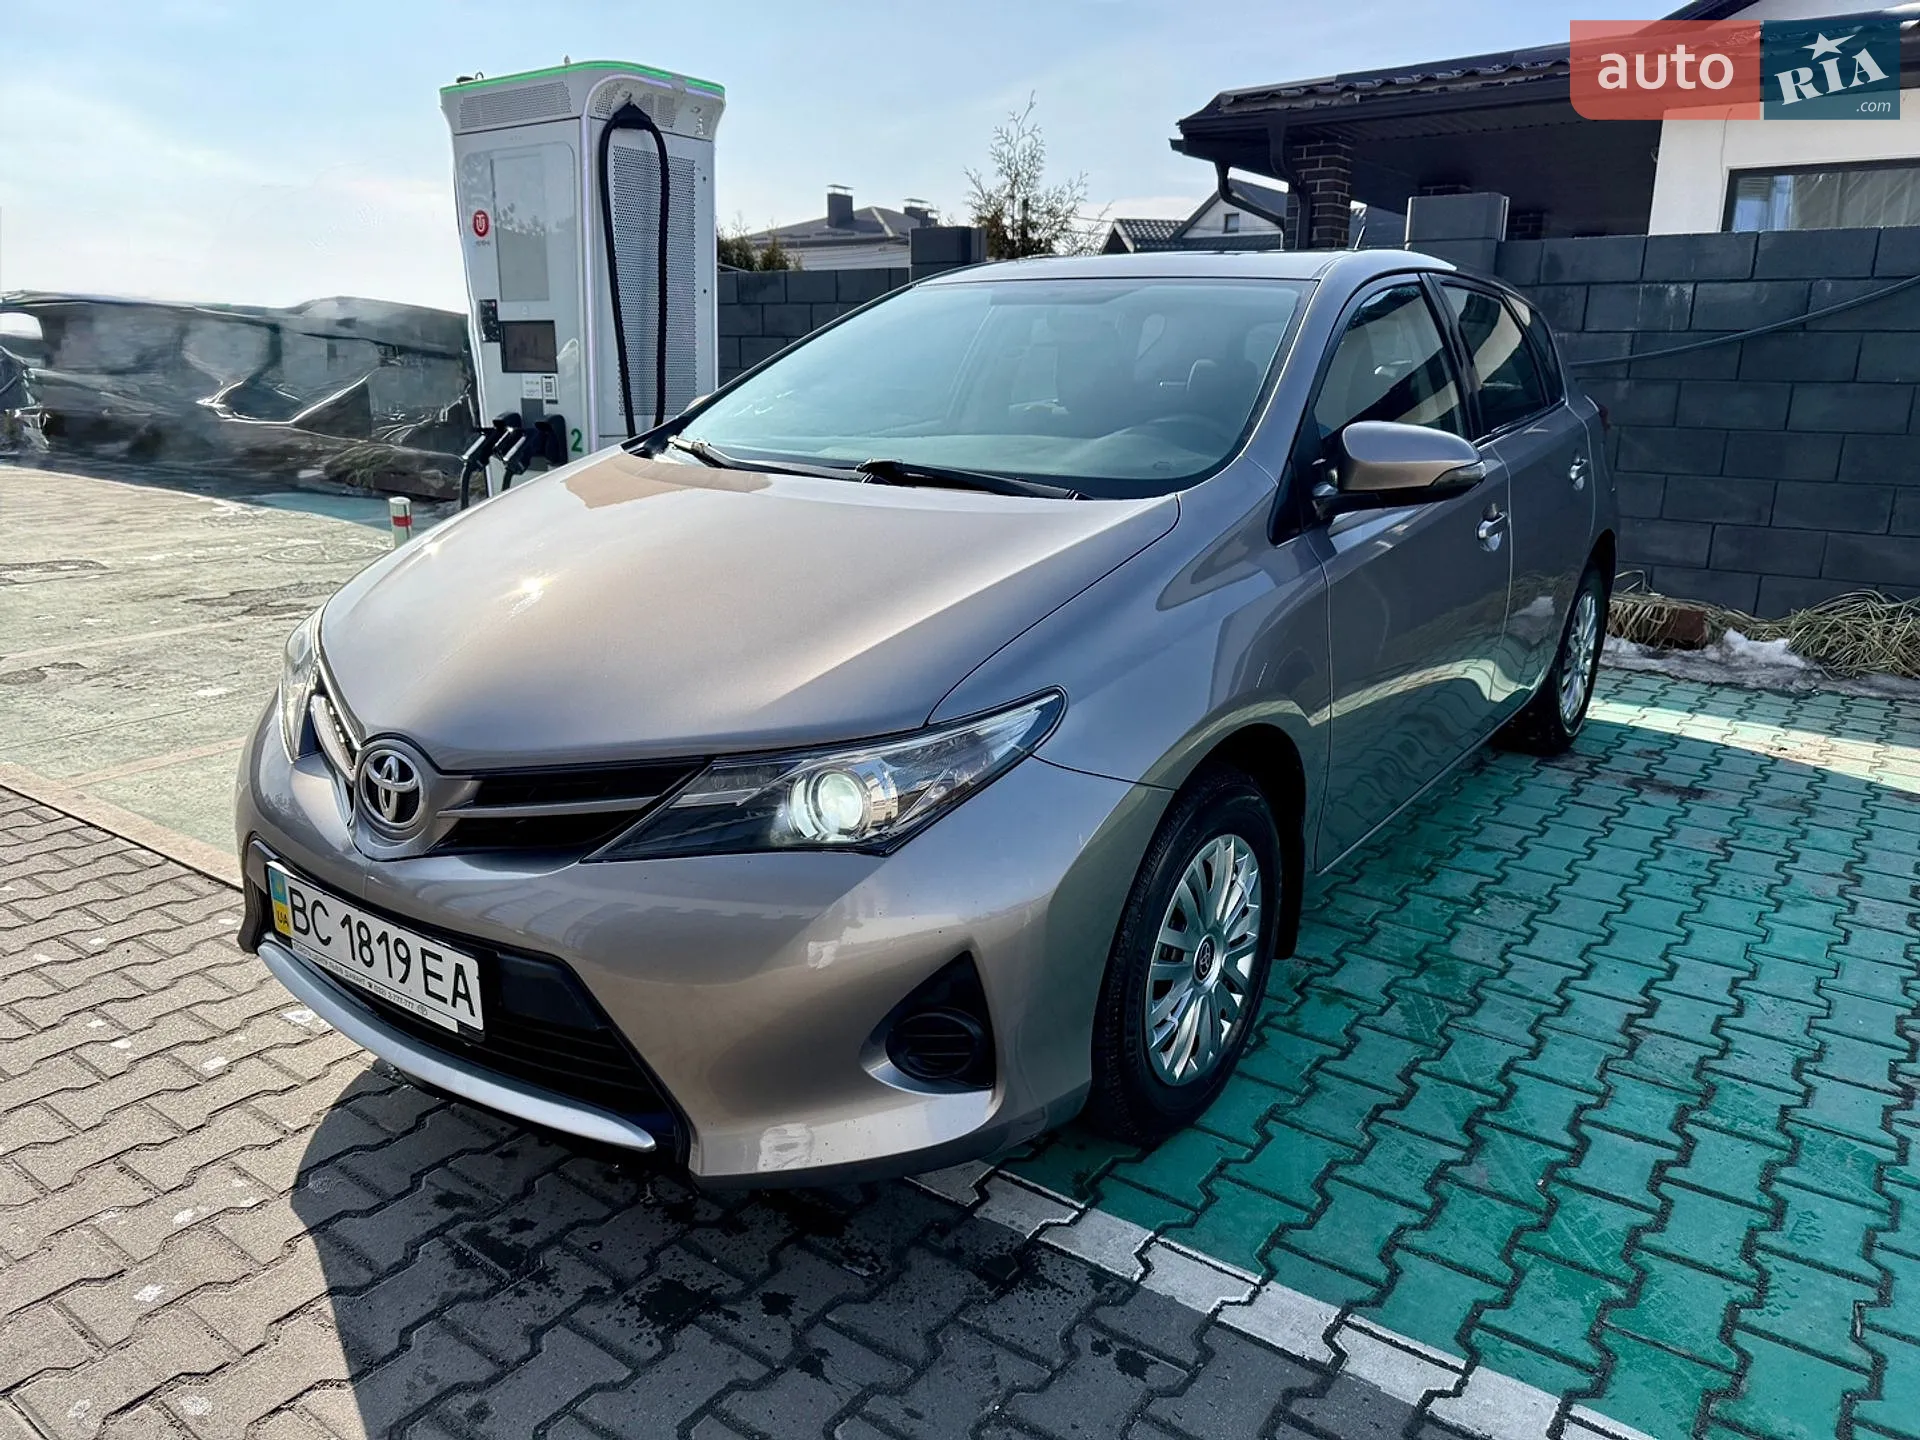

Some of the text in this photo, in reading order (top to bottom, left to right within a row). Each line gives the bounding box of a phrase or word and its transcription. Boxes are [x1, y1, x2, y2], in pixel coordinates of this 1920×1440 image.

[570, 427, 583, 452] 2
[276, 910, 290, 928] UA
[288, 885, 331, 946] BC
[340, 913, 412, 985] 1819
[420, 946, 477, 1018] EA
